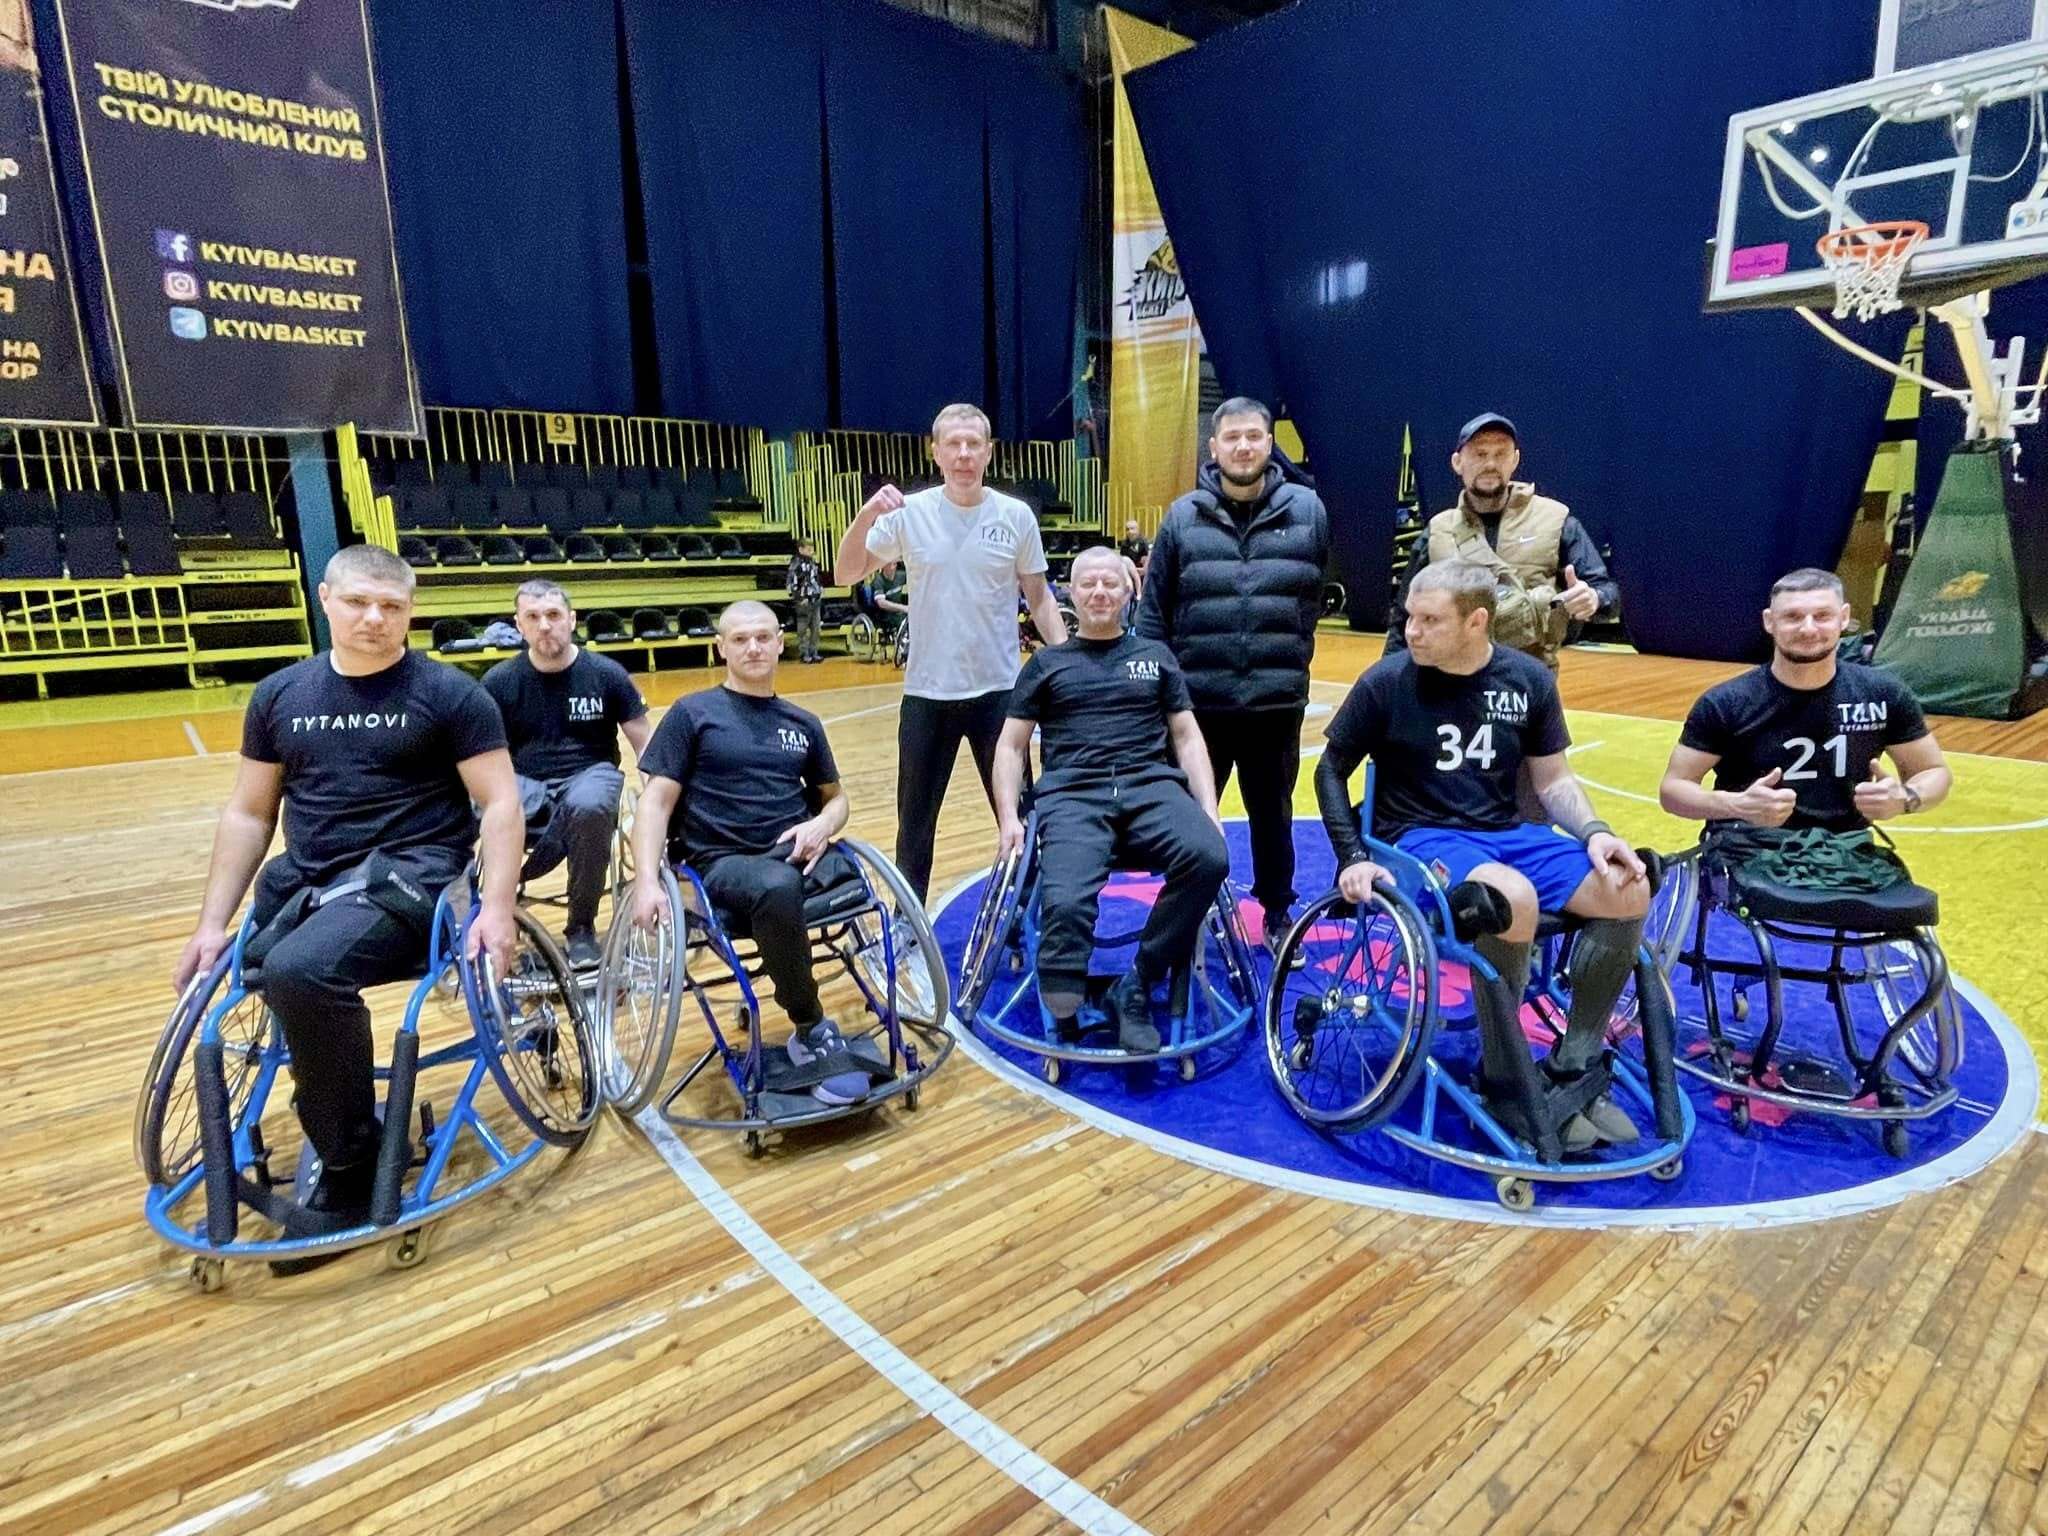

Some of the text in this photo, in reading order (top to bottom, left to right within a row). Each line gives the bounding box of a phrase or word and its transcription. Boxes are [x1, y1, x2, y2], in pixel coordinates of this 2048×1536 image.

[95, 61, 361, 133] ТВІЙ УЛЮБЛЕНИЙ
[98, 95, 367, 161] СТОЛИЧНИЙ КЛУБ
[201, 241, 357, 276] KYIVBASKET
[208, 280, 363, 313] KYIVBASKET
[213, 317, 367, 348] KYIVBASKET
[554, 415, 567, 434] 9
[291, 712, 406, 733] TYTANOVI
[1436, 723, 1496, 771] 34
[1782, 734, 1848, 780] 21
